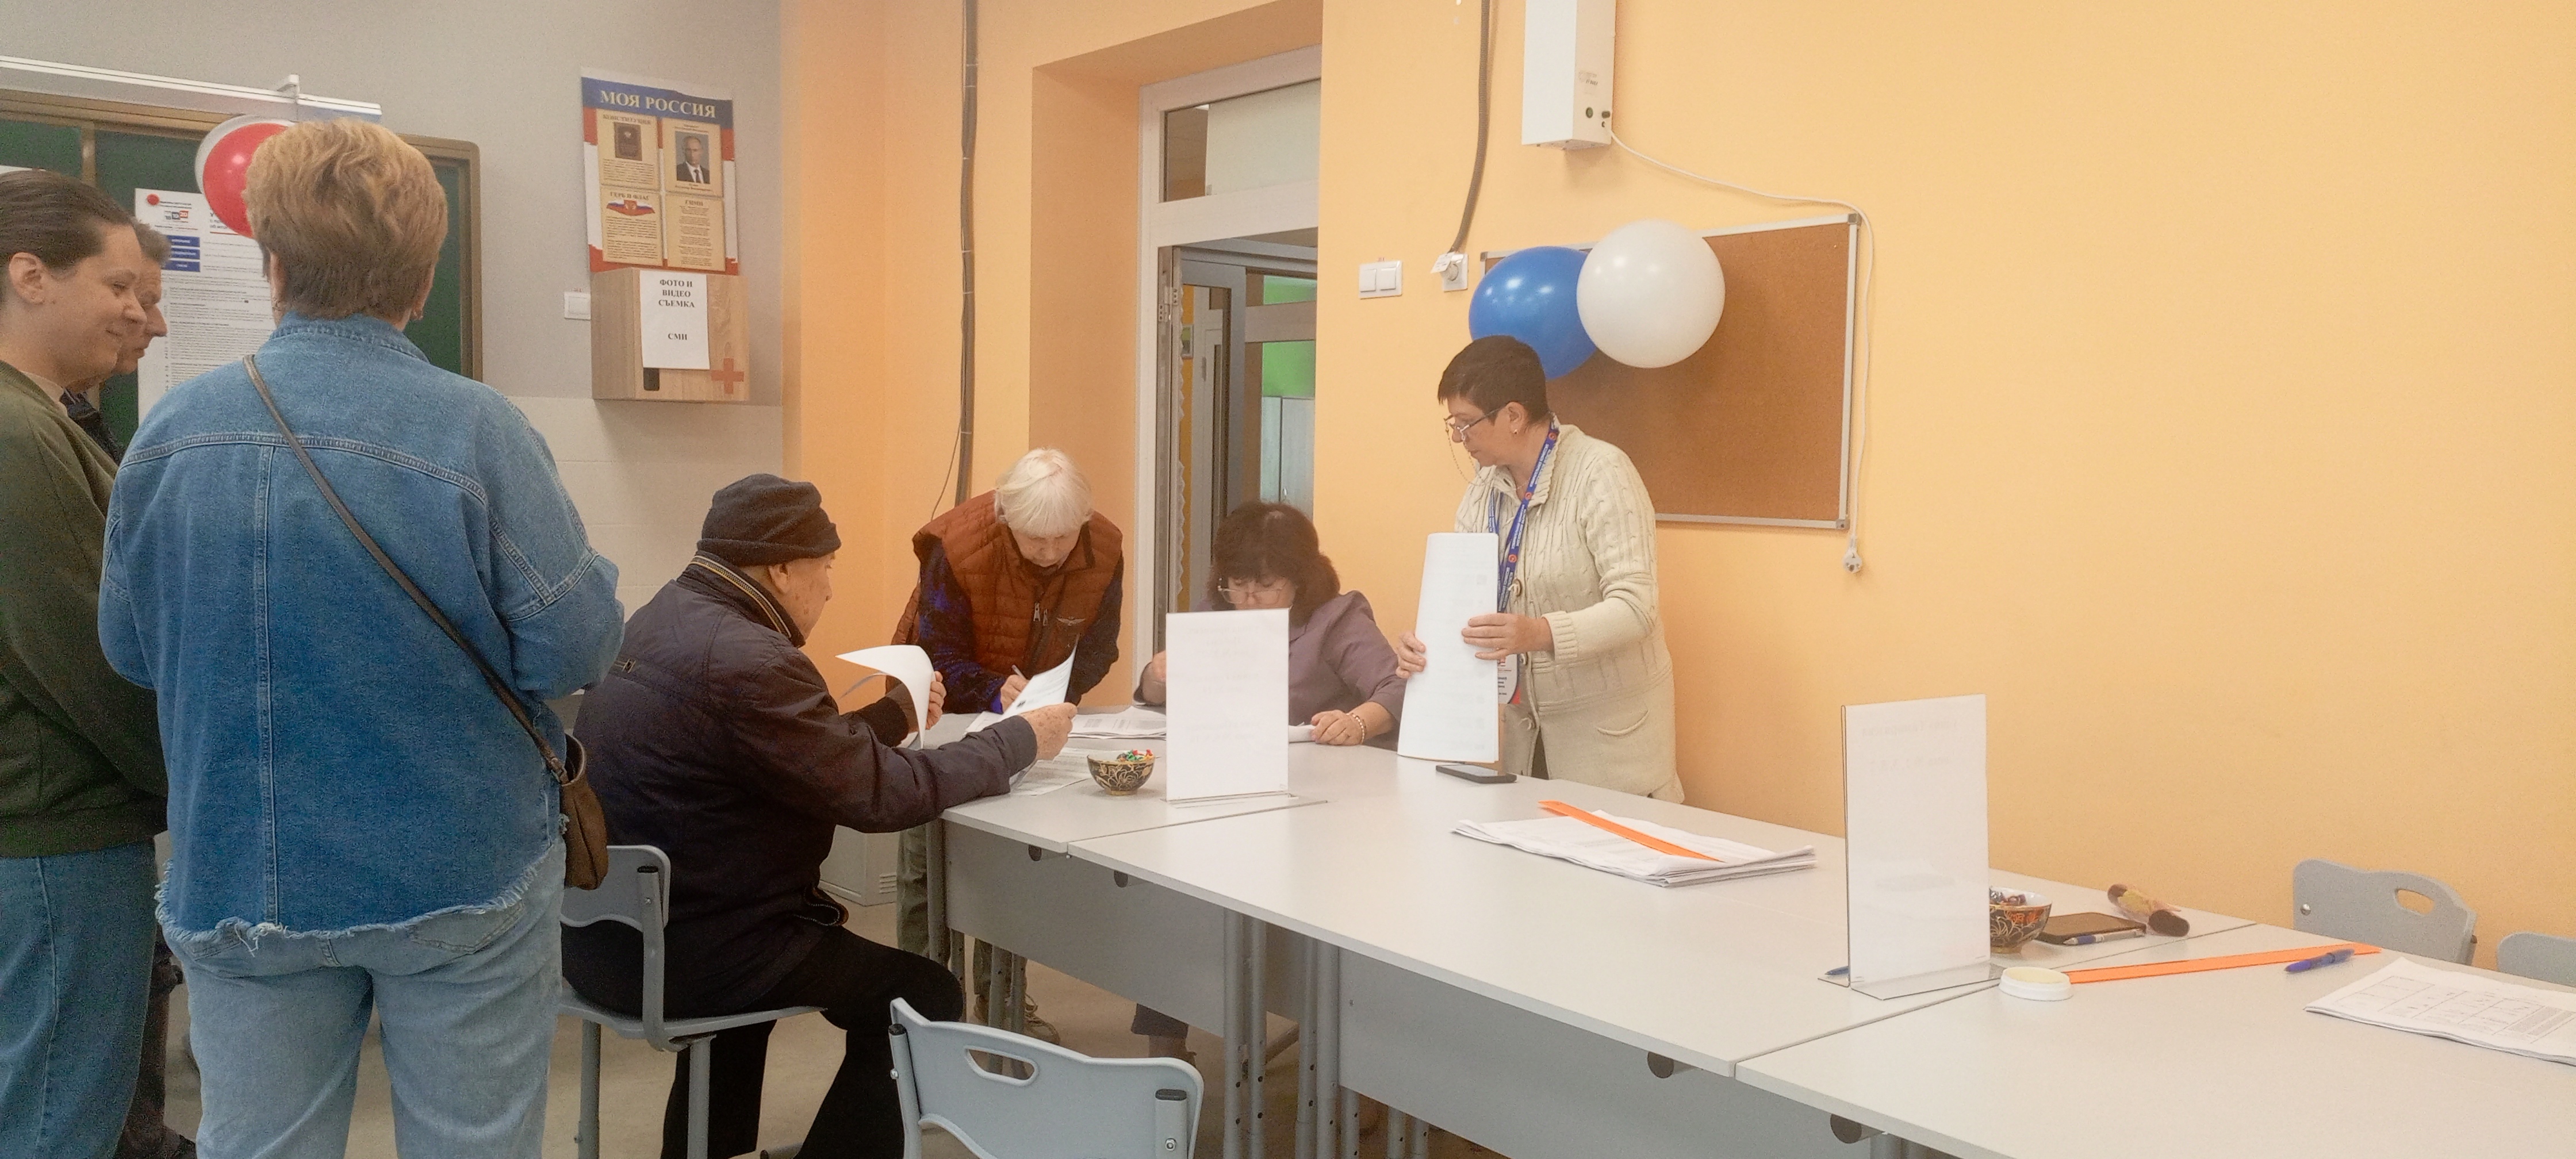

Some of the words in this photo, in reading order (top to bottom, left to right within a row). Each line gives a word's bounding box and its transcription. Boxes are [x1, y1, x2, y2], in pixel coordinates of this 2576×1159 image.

[600, 90, 640, 108] МОЯ
[645, 96, 716, 118] РОССИЯ
[662, 289, 691, 297] ВИДЕО
[658, 299, 695, 308] СЪЕМКА
